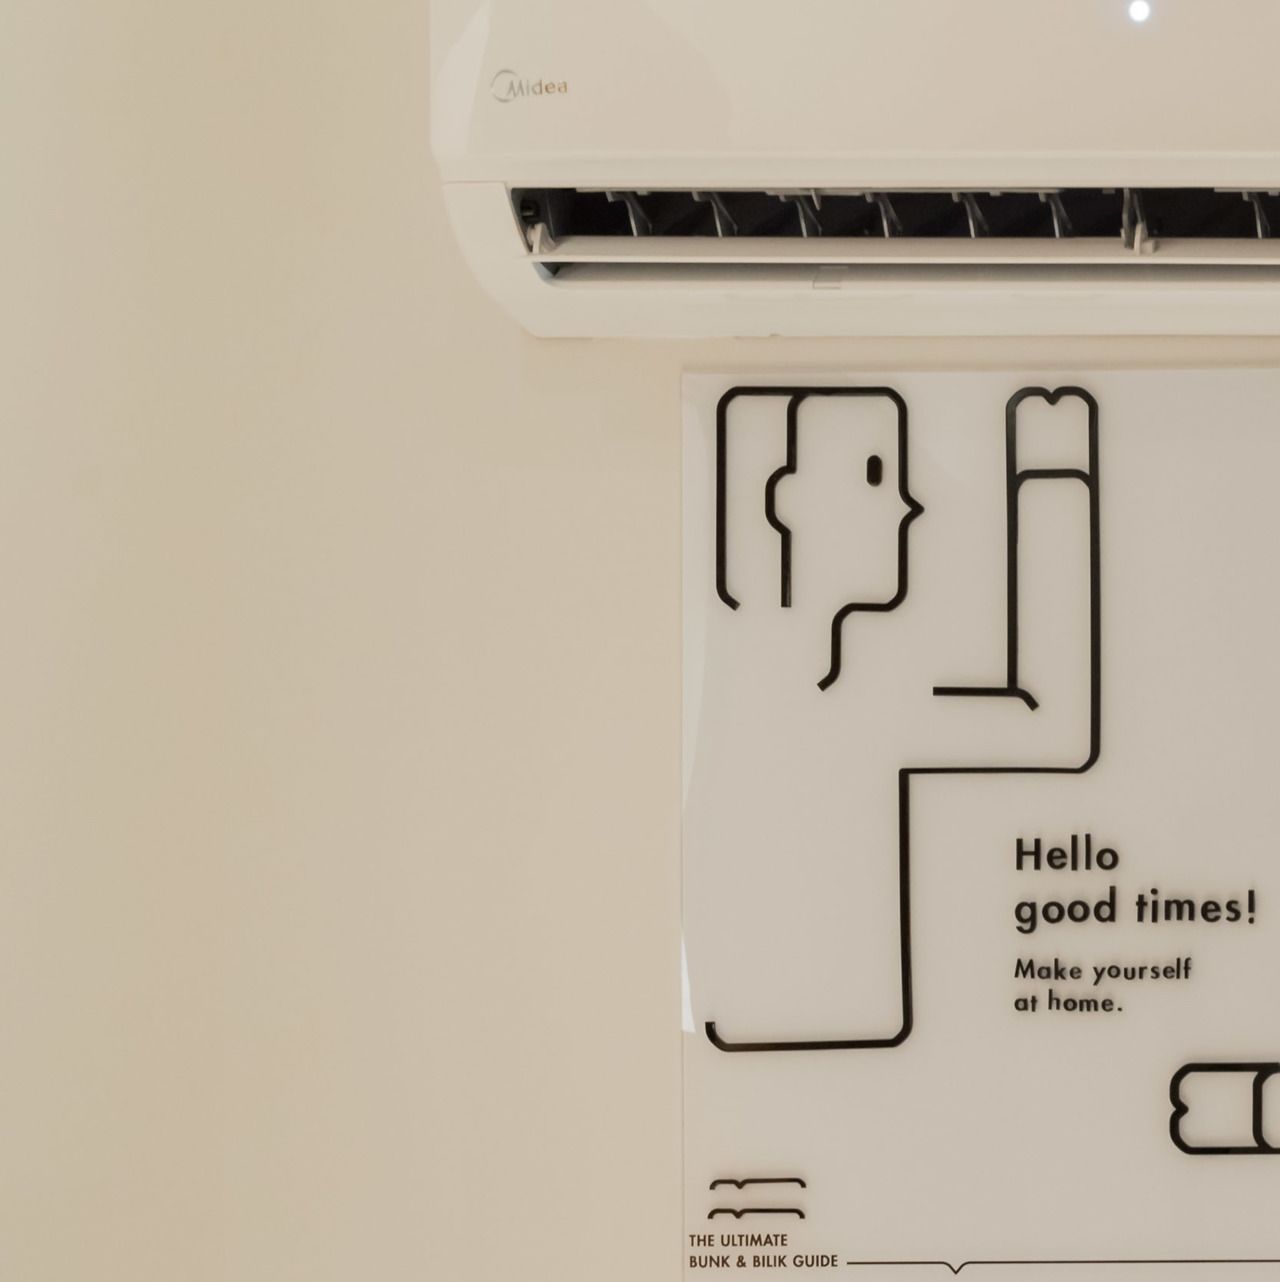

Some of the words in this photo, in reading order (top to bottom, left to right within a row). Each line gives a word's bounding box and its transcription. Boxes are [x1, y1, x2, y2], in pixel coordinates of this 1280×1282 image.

[504, 77, 568, 98] Midea
[1016, 833, 1120, 871] Hello
[1015, 885, 1117, 934] good
[1136, 888, 1256, 924] times!
[1014, 958, 1082, 981] Make
[1093, 957, 1192, 986] yourself
[1014, 995, 1038, 1012] at
[1048, 988, 1122, 1012] home.
[689, 1234, 714, 1247] THE
[721, 1234, 788, 1247] ULTIMATE
[690, 1255, 730, 1268] BUNK
[736, 1255, 746, 1268] &
[753, 1255, 787, 1268] BILIK
[793, 1254, 838, 1268] GUIDE
